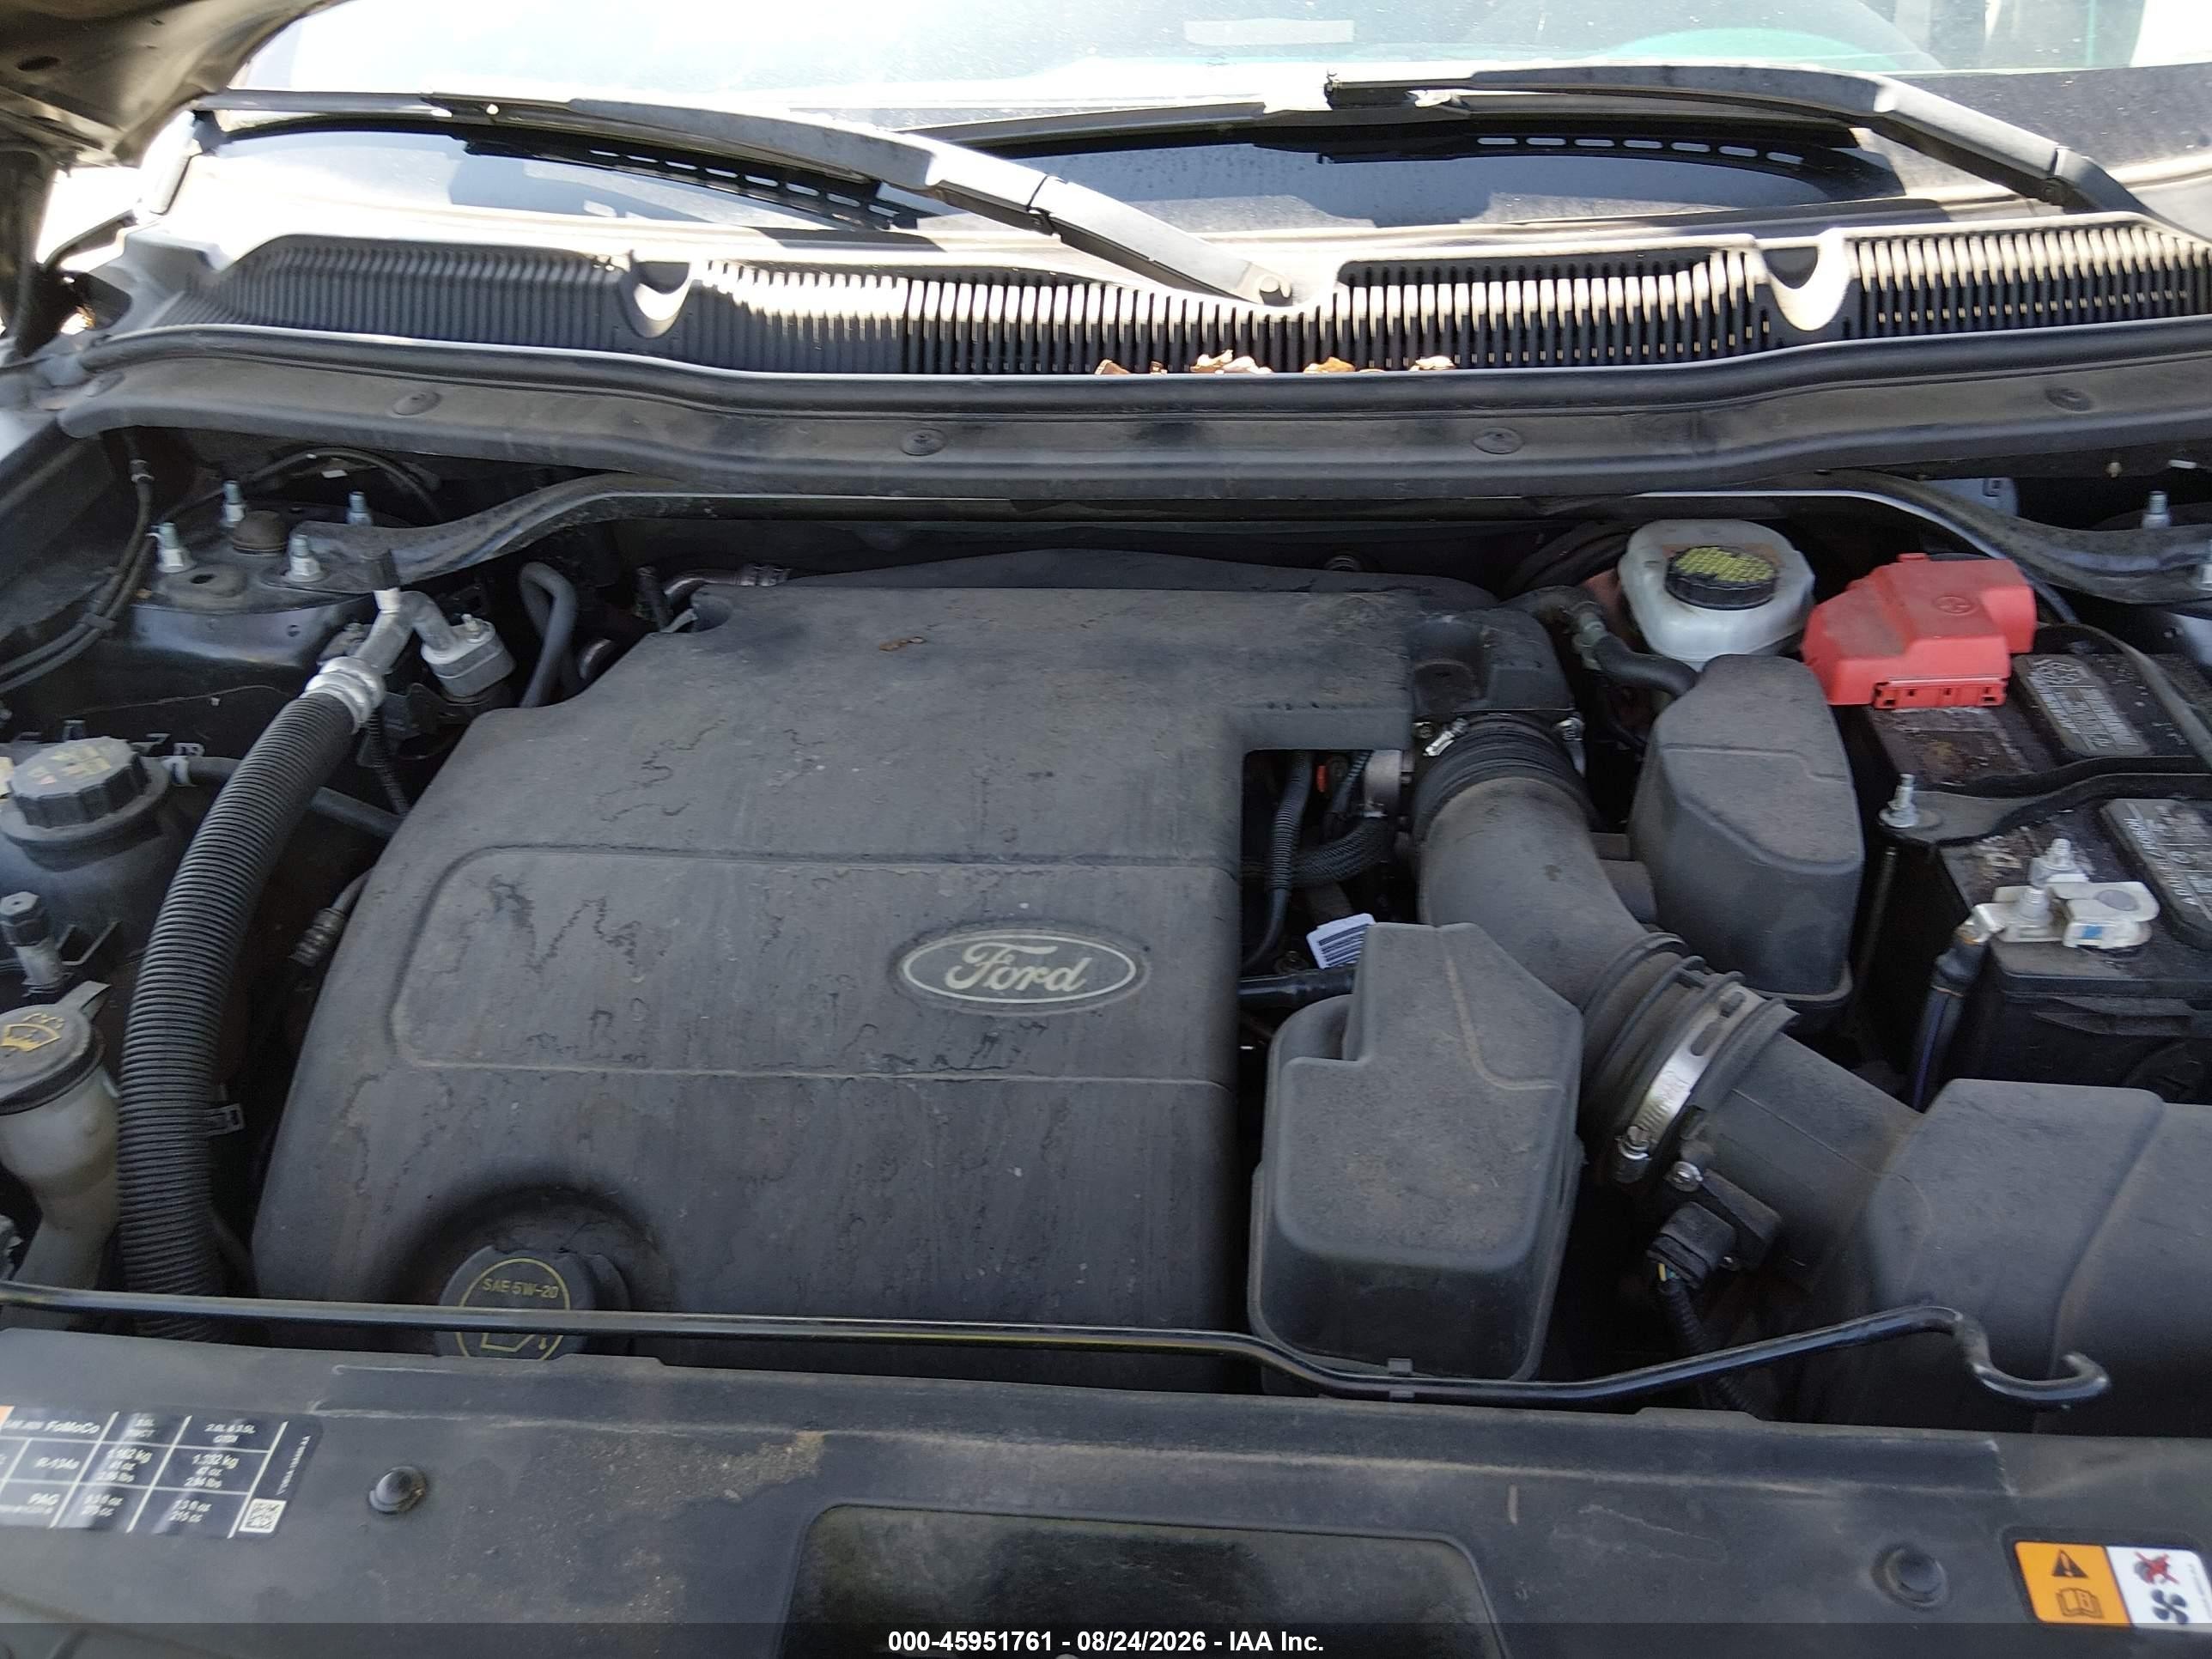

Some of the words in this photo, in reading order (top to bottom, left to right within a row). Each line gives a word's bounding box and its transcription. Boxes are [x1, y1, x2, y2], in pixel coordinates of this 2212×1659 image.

[945, 942, 1093, 992] Ford
[483, 1278, 511, 1293] SAE
[511, 1281, 560, 1299] 5W-20
[45, 1420, 100, 1434] FoMoCo
[221, 1455, 240, 1469] kg
[27, 1493, 60, 1505] PAG
